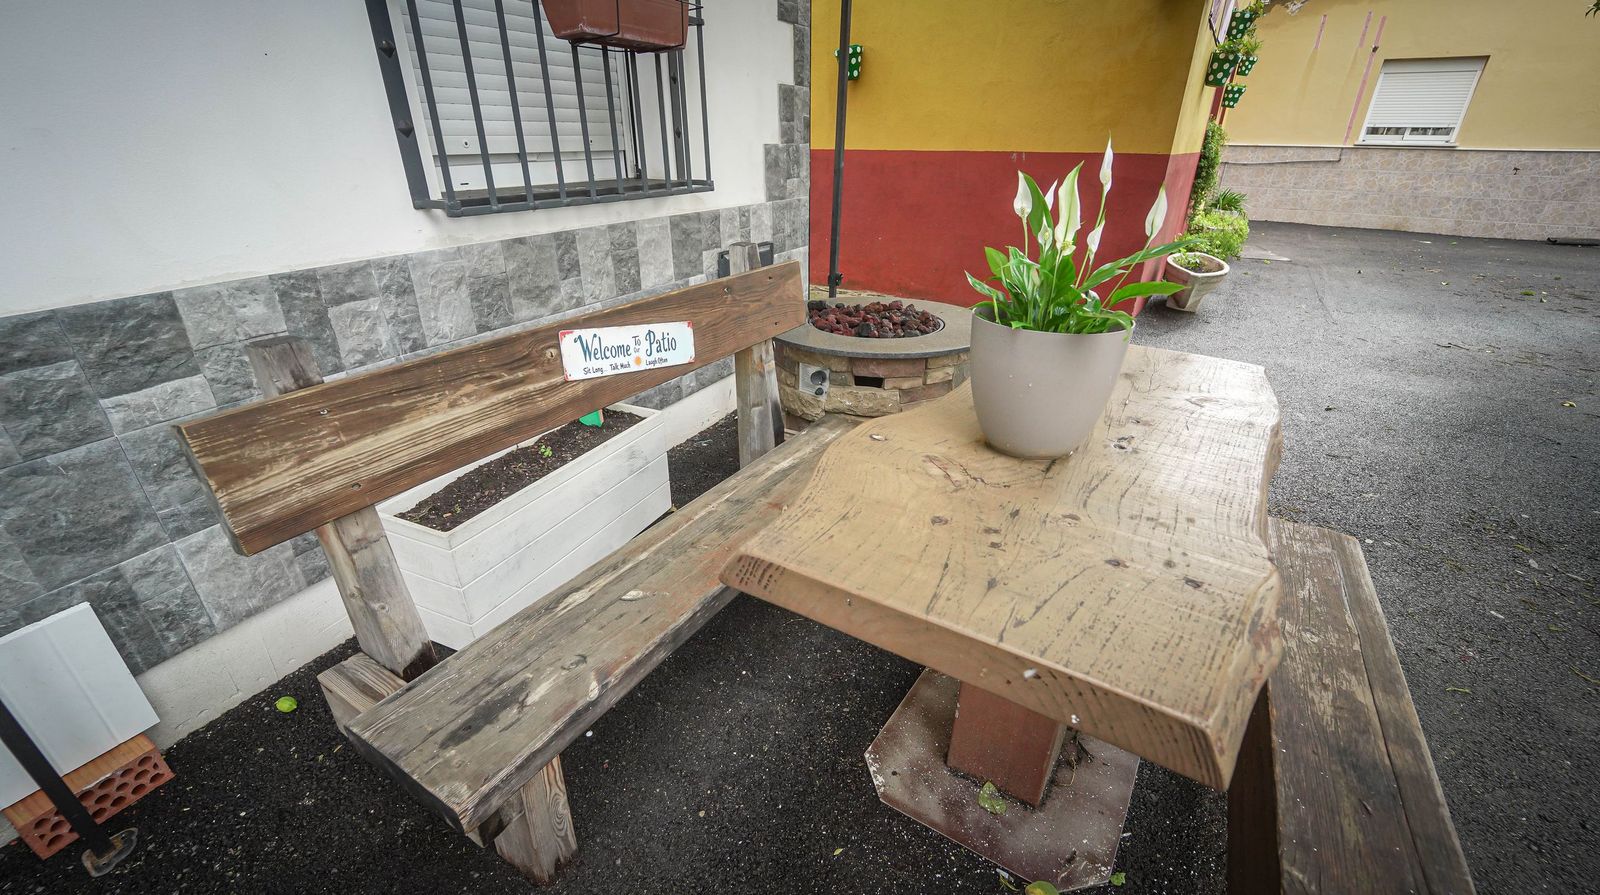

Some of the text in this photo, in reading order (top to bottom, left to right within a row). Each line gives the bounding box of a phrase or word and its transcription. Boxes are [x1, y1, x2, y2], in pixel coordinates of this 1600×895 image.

[574, 333, 632, 362] Welcome
[631, 335, 642, 346] To
[645, 329, 677, 356] Patio
[620, 361, 631, 369] Much
[645, 357, 657, 367] Laugh
[657, 356, 669, 365] Often
